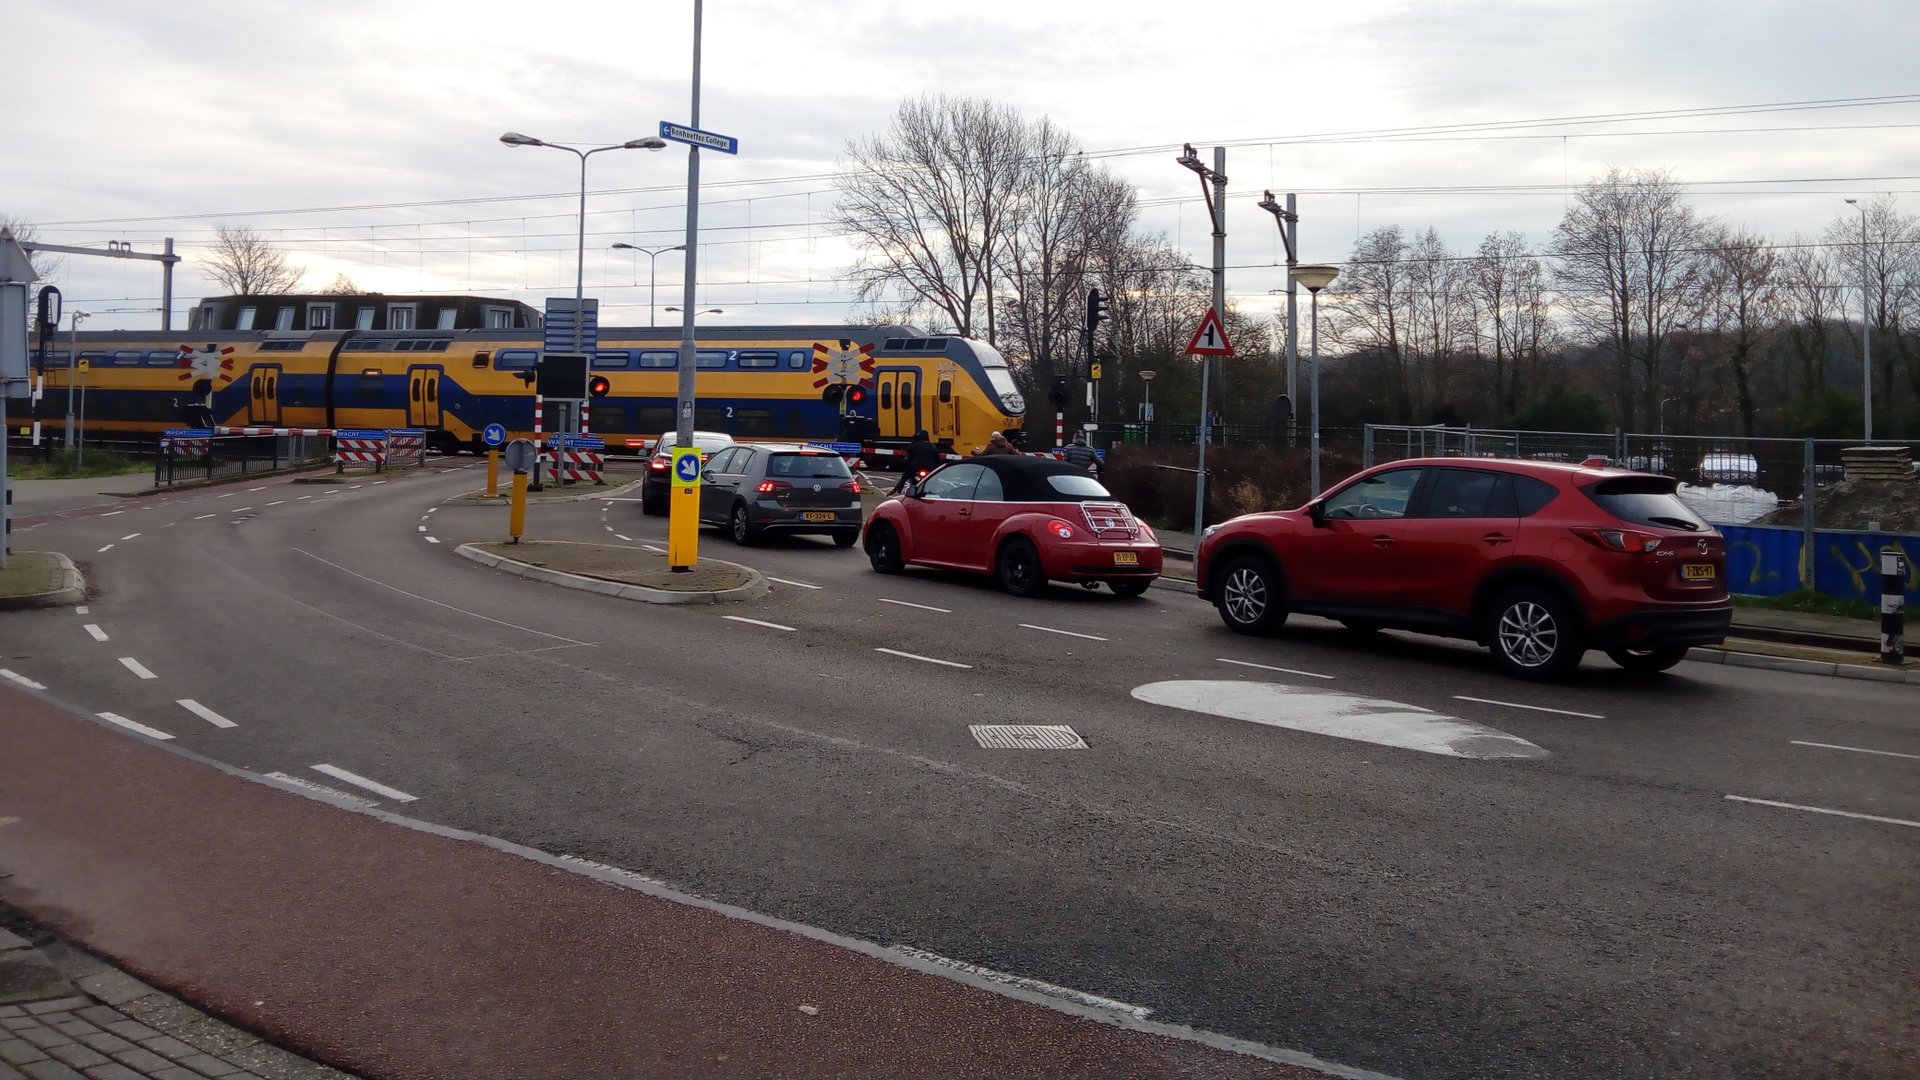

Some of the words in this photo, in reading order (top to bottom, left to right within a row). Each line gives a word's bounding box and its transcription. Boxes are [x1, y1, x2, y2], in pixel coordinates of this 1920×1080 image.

[705, 136, 728, 147] College
[729, 350, 737, 360] 2
[173, 397, 179, 407] 2
[726, 406, 733, 418] 2
